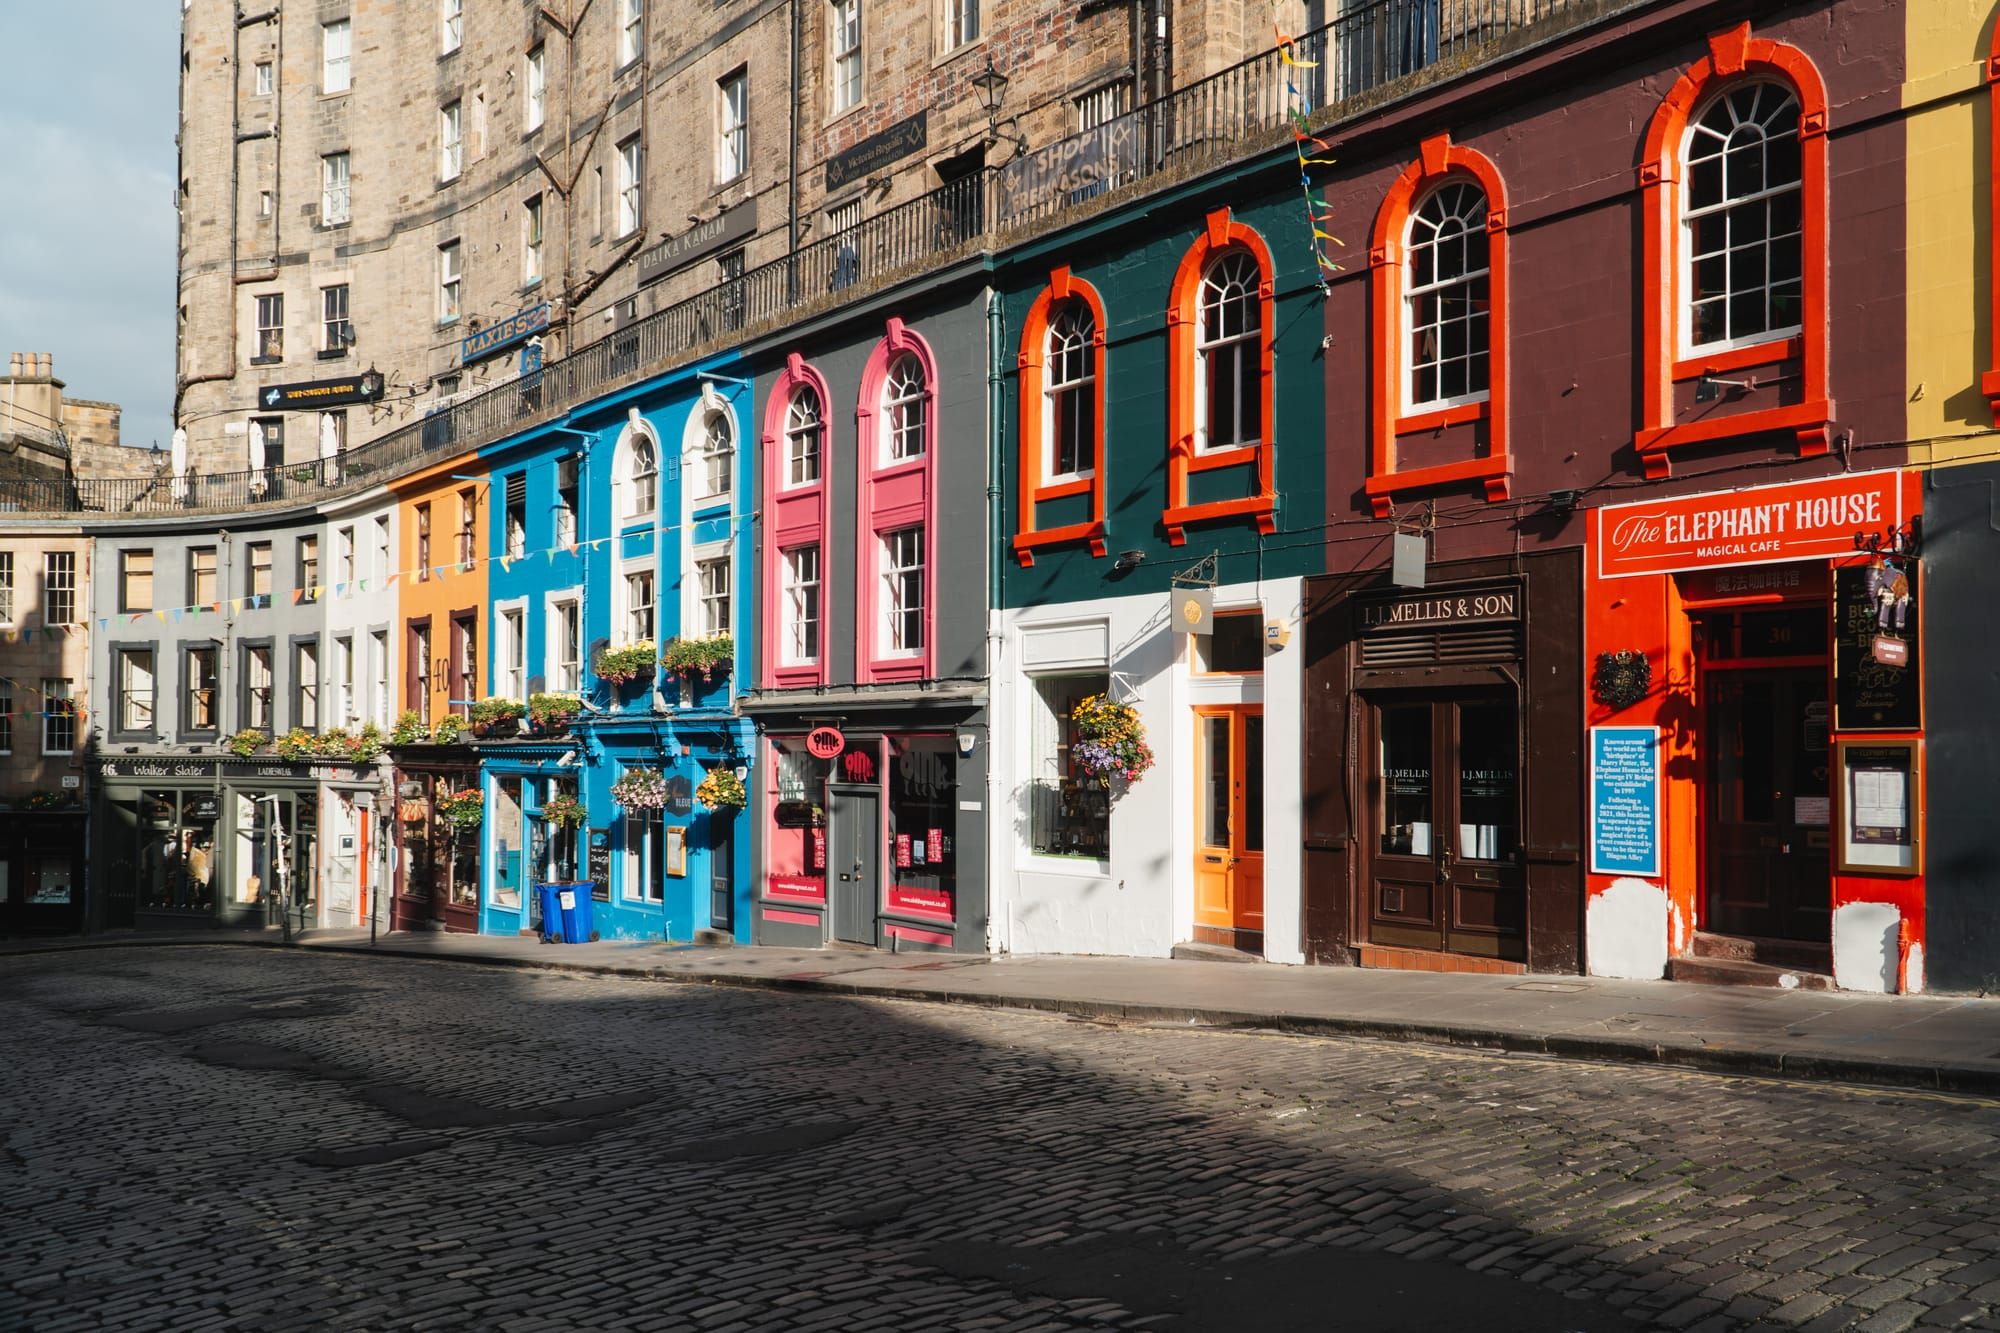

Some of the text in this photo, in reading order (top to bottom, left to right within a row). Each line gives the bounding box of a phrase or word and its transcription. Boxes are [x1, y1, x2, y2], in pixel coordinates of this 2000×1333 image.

[848, 136, 903, 169] Victoria Regalia
[1038, 132, 1093, 173] SHOP
[1011, 154, 1119, 210] FREEMASONS
[643, 217, 726, 269] DAIKA KANAM
[463, 316, 527, 357] MAXIES
[1612, 491, 1882, 553] The ELEPHANT HOUSE
[1697, 540, 1781, 558] MAGICAL CAFE
[1389, 600, 1452, 623] MELLIS
[1457, 598, 1469, 617] &
[1474, 595, 1514, 617] SON
[433, 658, 449, 692] 40
[133, 765, 170, 776] Walker
[174, 765, 205, 776] Slater
[1604, 773, 1625, 781] George
[675, 797, 691, 808] BLEUE
[1600, 803, 1632, 811] devastating
[1606, 852, 1643, 862] Diagon Alley
